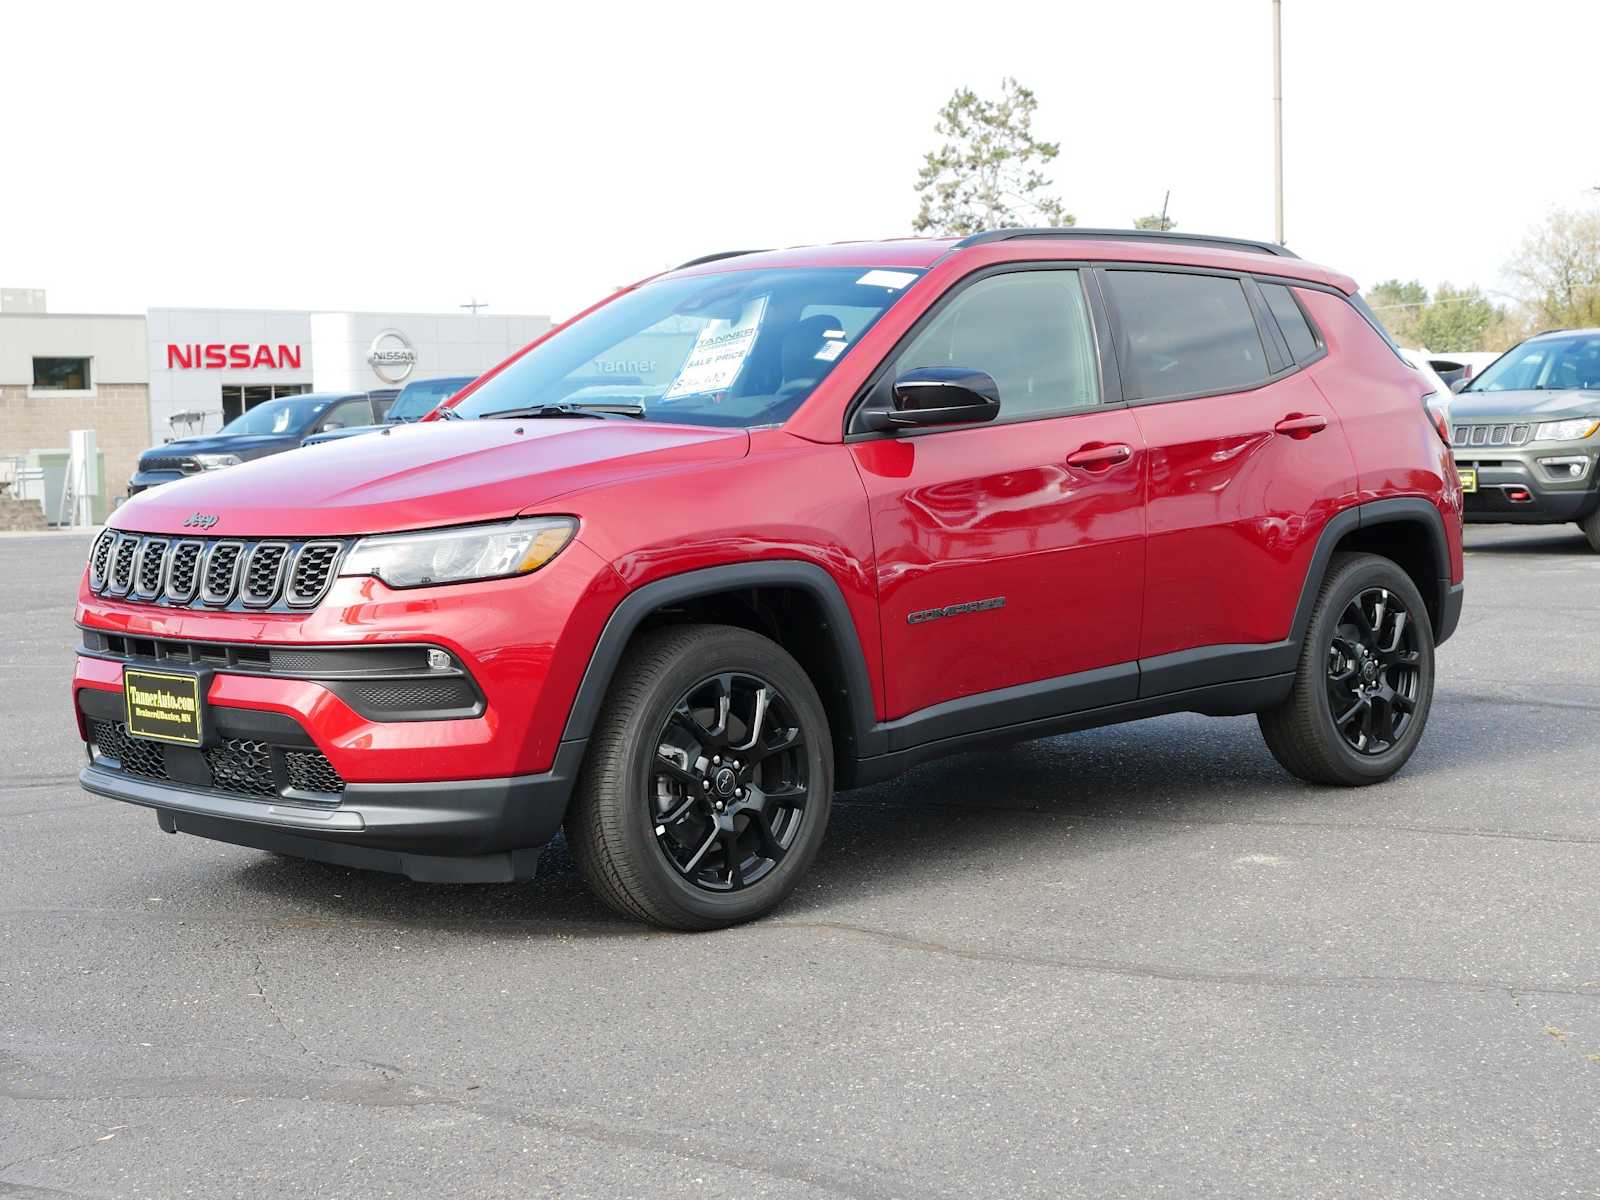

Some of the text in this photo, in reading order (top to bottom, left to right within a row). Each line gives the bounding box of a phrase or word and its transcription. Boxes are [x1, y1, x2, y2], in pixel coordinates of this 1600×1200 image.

[167, 344, 301, 369] NISSAN
[373, 351, 414, 361] NISSAN
[687, 350, 745, 368] SALE PRICE
[594, 359, 656, 373] Tanner
[183, 512, 219, 530] Jeep
[907, 597, 1006, 624] COMPASS
[129, 685, 195, 711] TannerAuto.com
